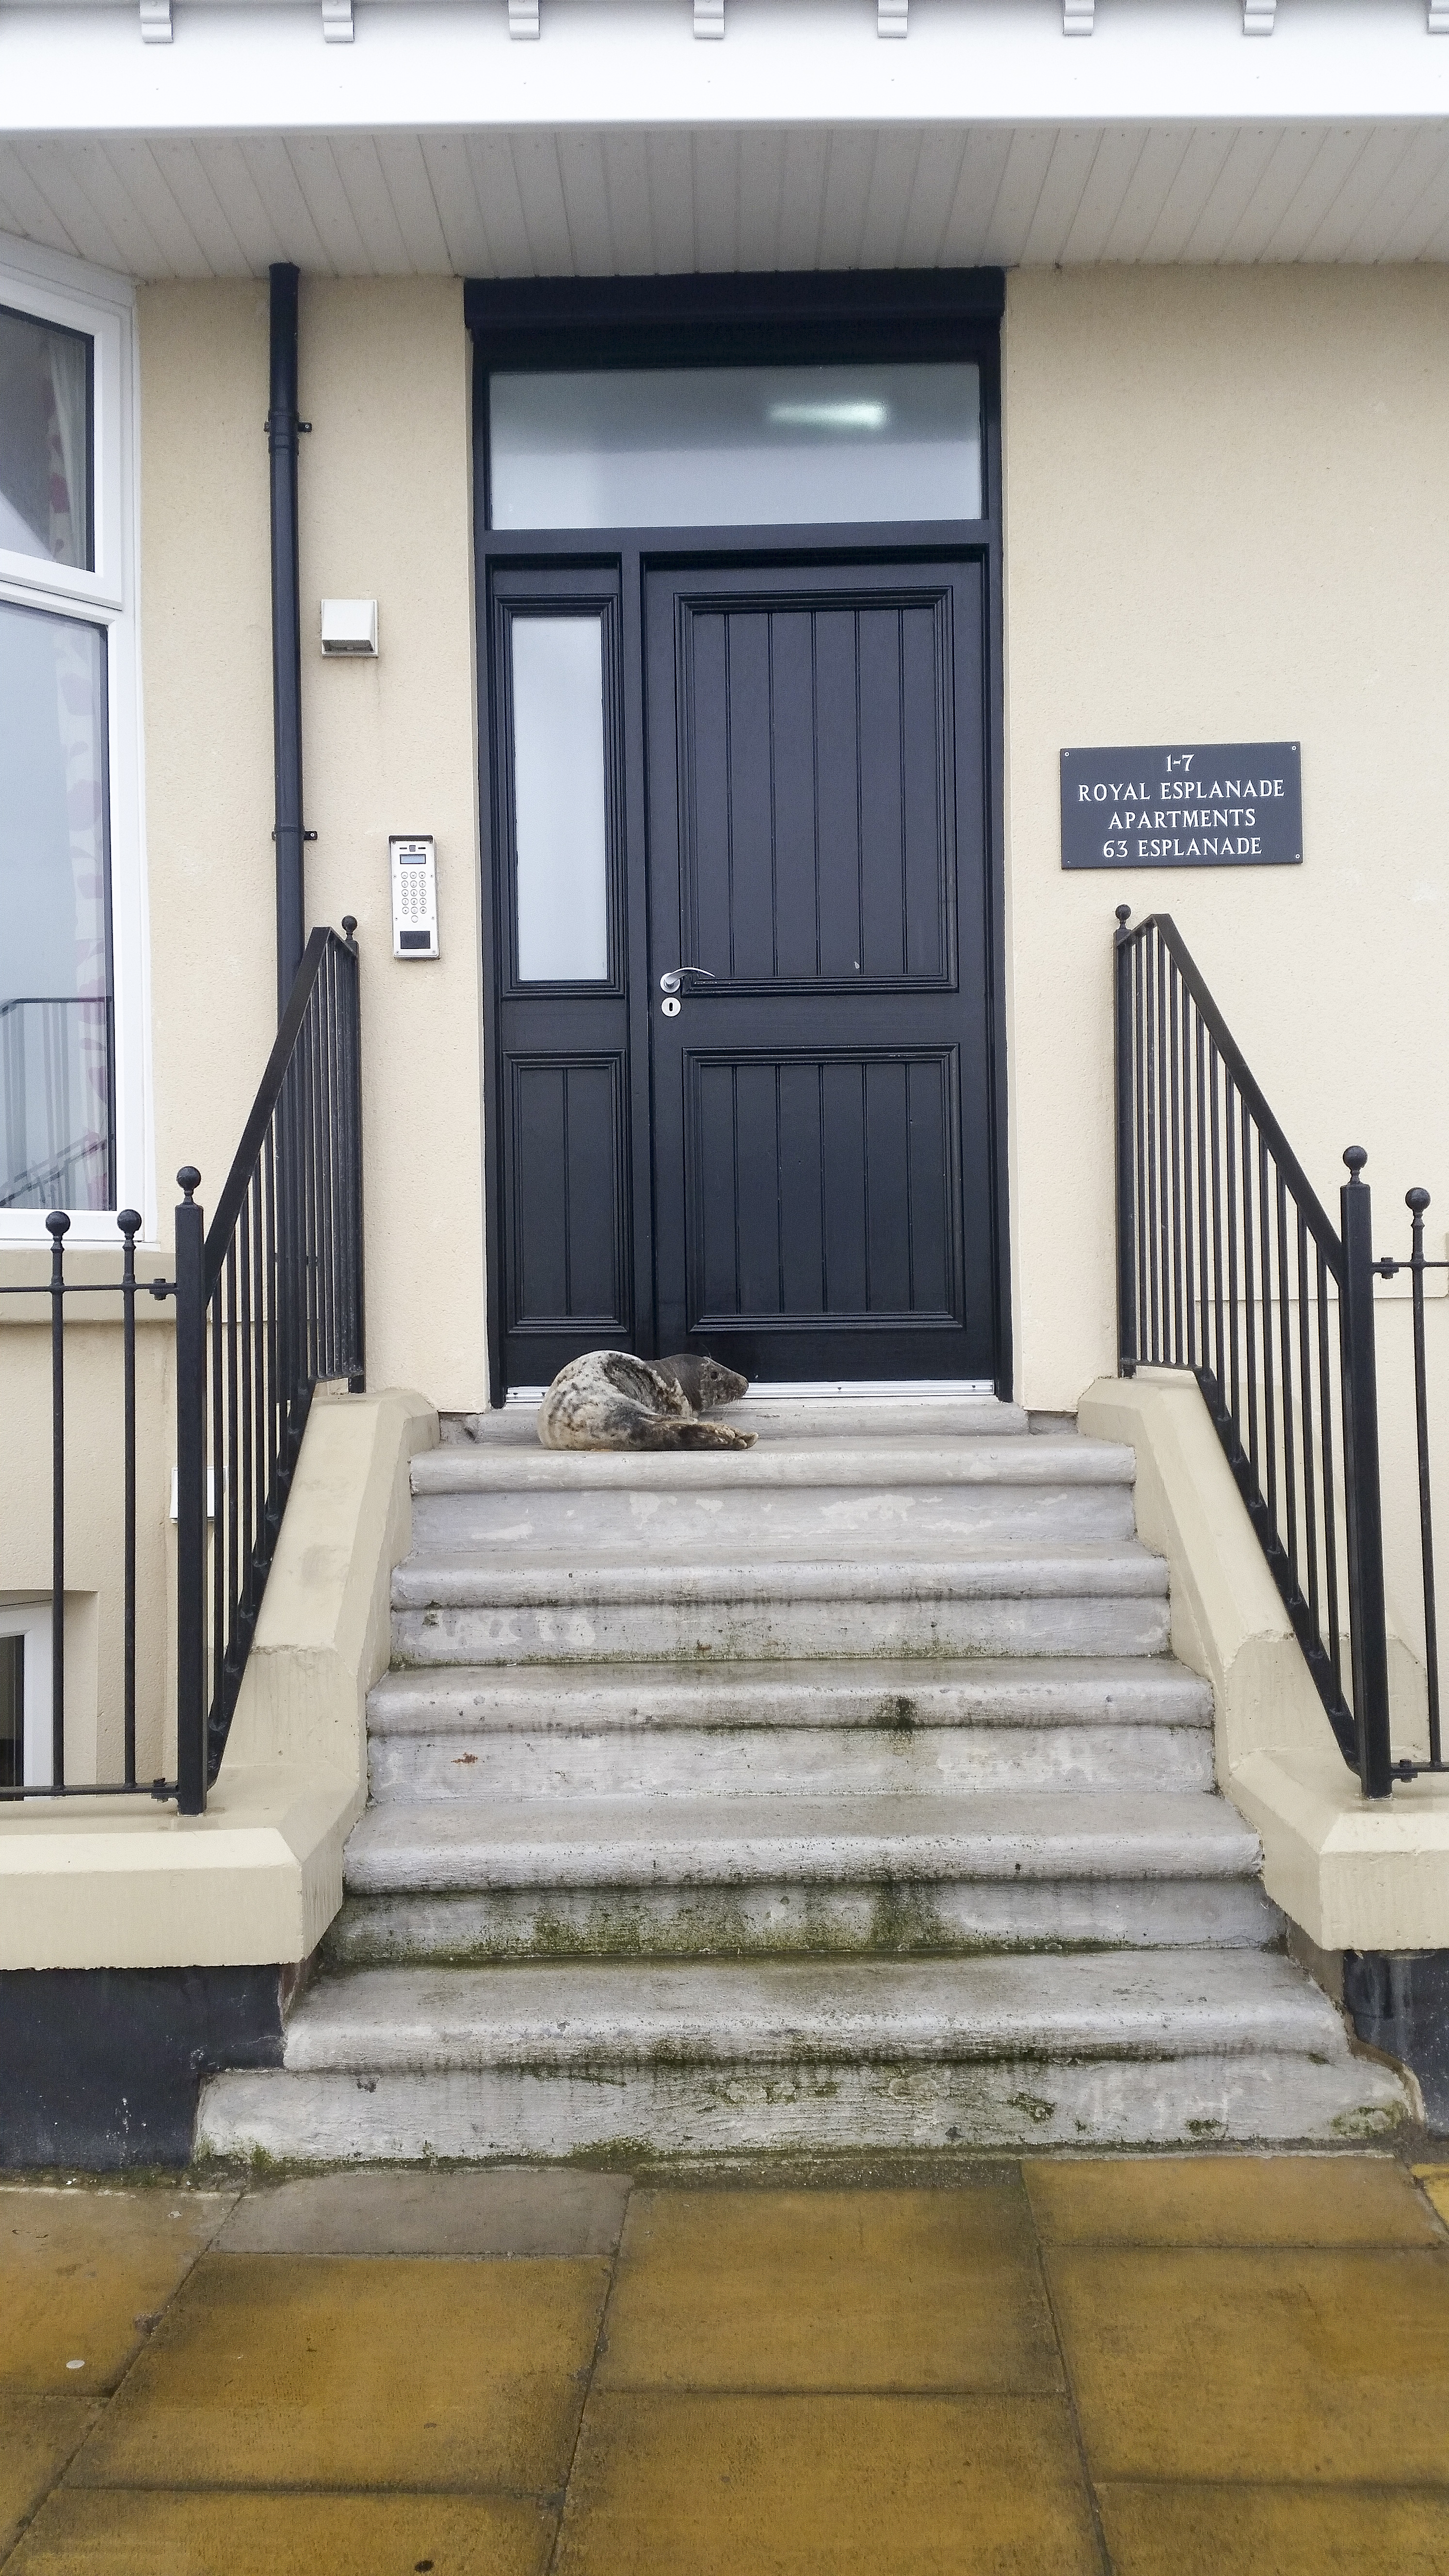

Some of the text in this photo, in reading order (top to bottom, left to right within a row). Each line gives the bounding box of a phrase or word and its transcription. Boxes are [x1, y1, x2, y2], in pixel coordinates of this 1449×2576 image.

[1166, 754, 1195, 772] 1-7
[1078, 779, 1285, 802] ROYAL ESPLANADE
[1108, 808, 1256, 830] APARTMENTS
[1103, 837, 1262, 858] 63 ESPLANADE
